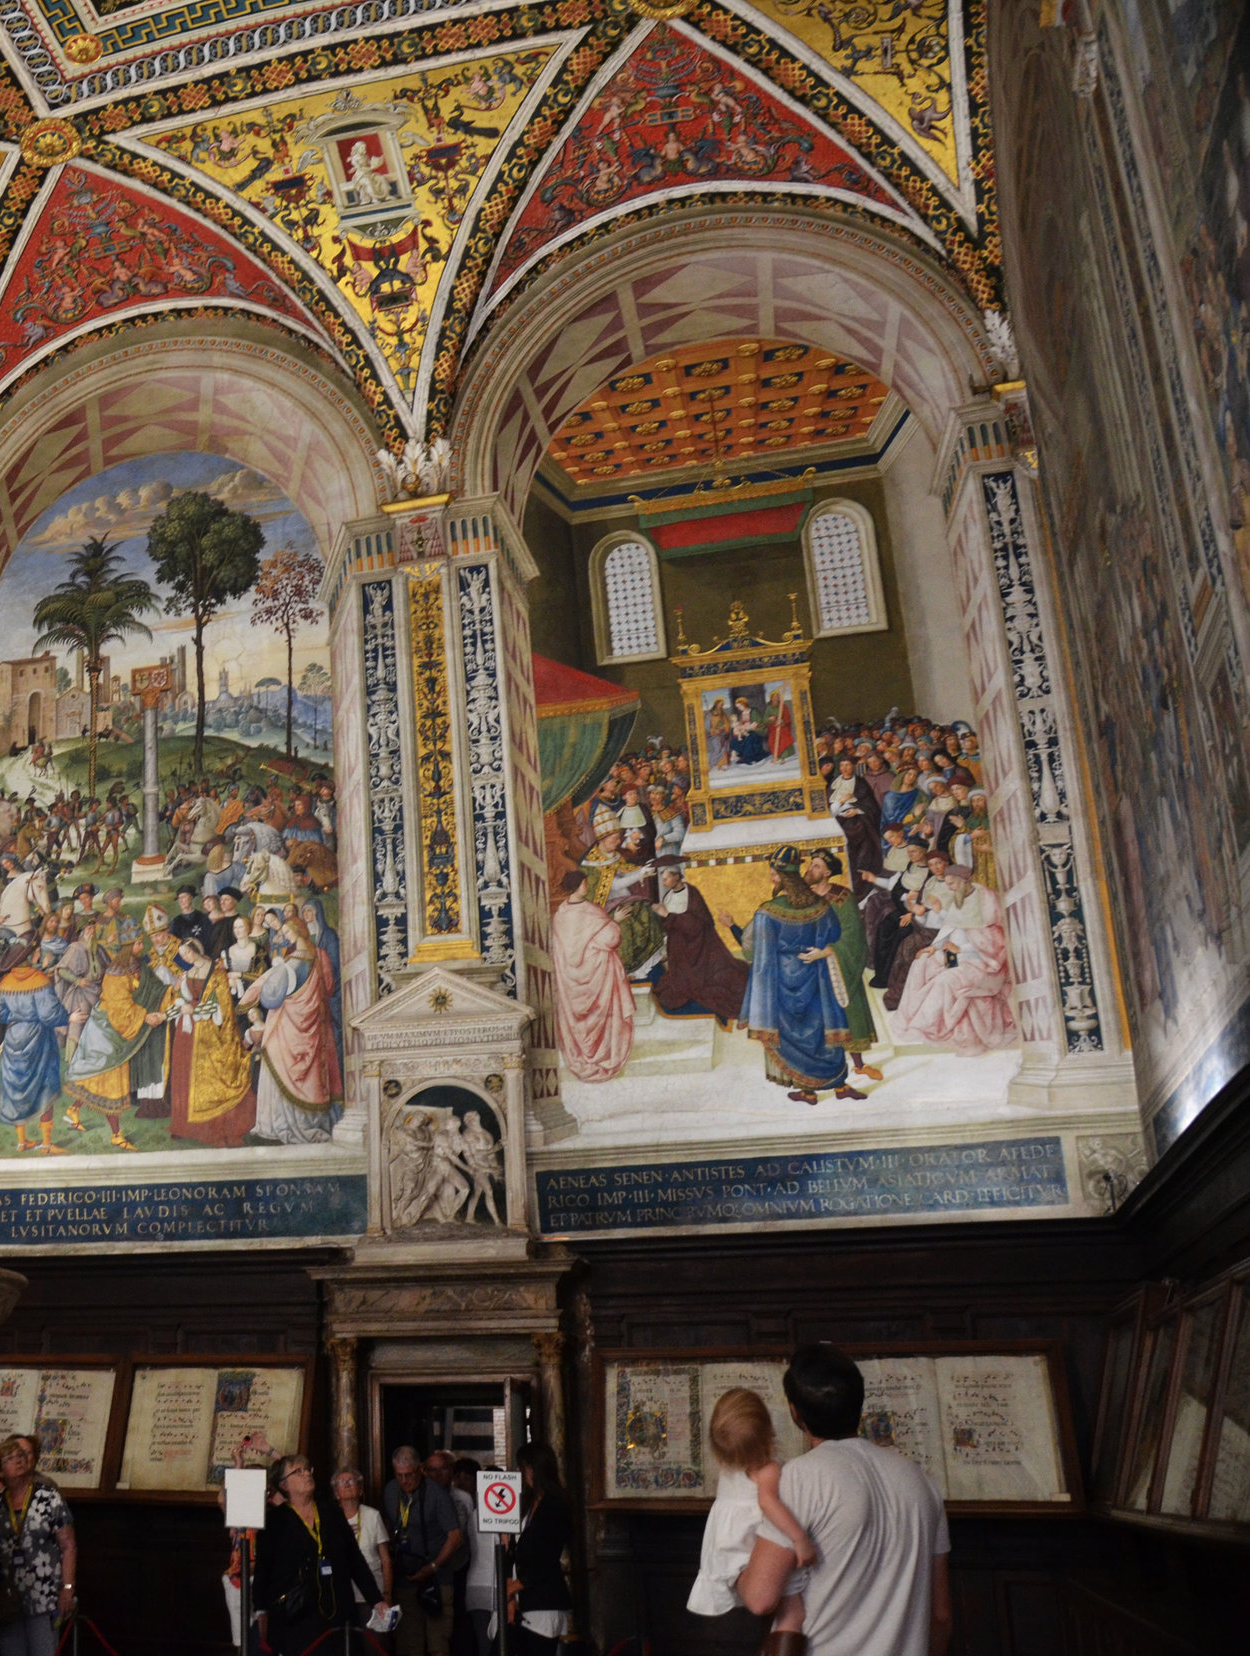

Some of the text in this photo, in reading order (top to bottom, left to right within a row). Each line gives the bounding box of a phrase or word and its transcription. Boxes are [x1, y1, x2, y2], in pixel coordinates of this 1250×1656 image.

[547, 1173, 607, 1191] AENEAS
[670, 1165, 745, 1183] ANTISTES
[754, 1163, 781, 1177] AD
[153, 1185, 247, 1202] LEONORAM
[547, 1194, 590, 1209] RICO
[657, 1186, 714, 1203] MISSVS
[774, 1181, 800, 1195] AD
[26, 1208, 43, 1222] ET
[47, 1206, 108, 1221] PVELLAE
[122, 1203, 189, 1219] LAVDIS
[202, 1203, 225, 1217] AC
[242, 1199, 314, 1214] REGVM
[549, 1212, 567, 1227] ET
[570, 1208, 632, 1226] PATRVM
[10, 1221, 129, 1239] LVSITANORVM
